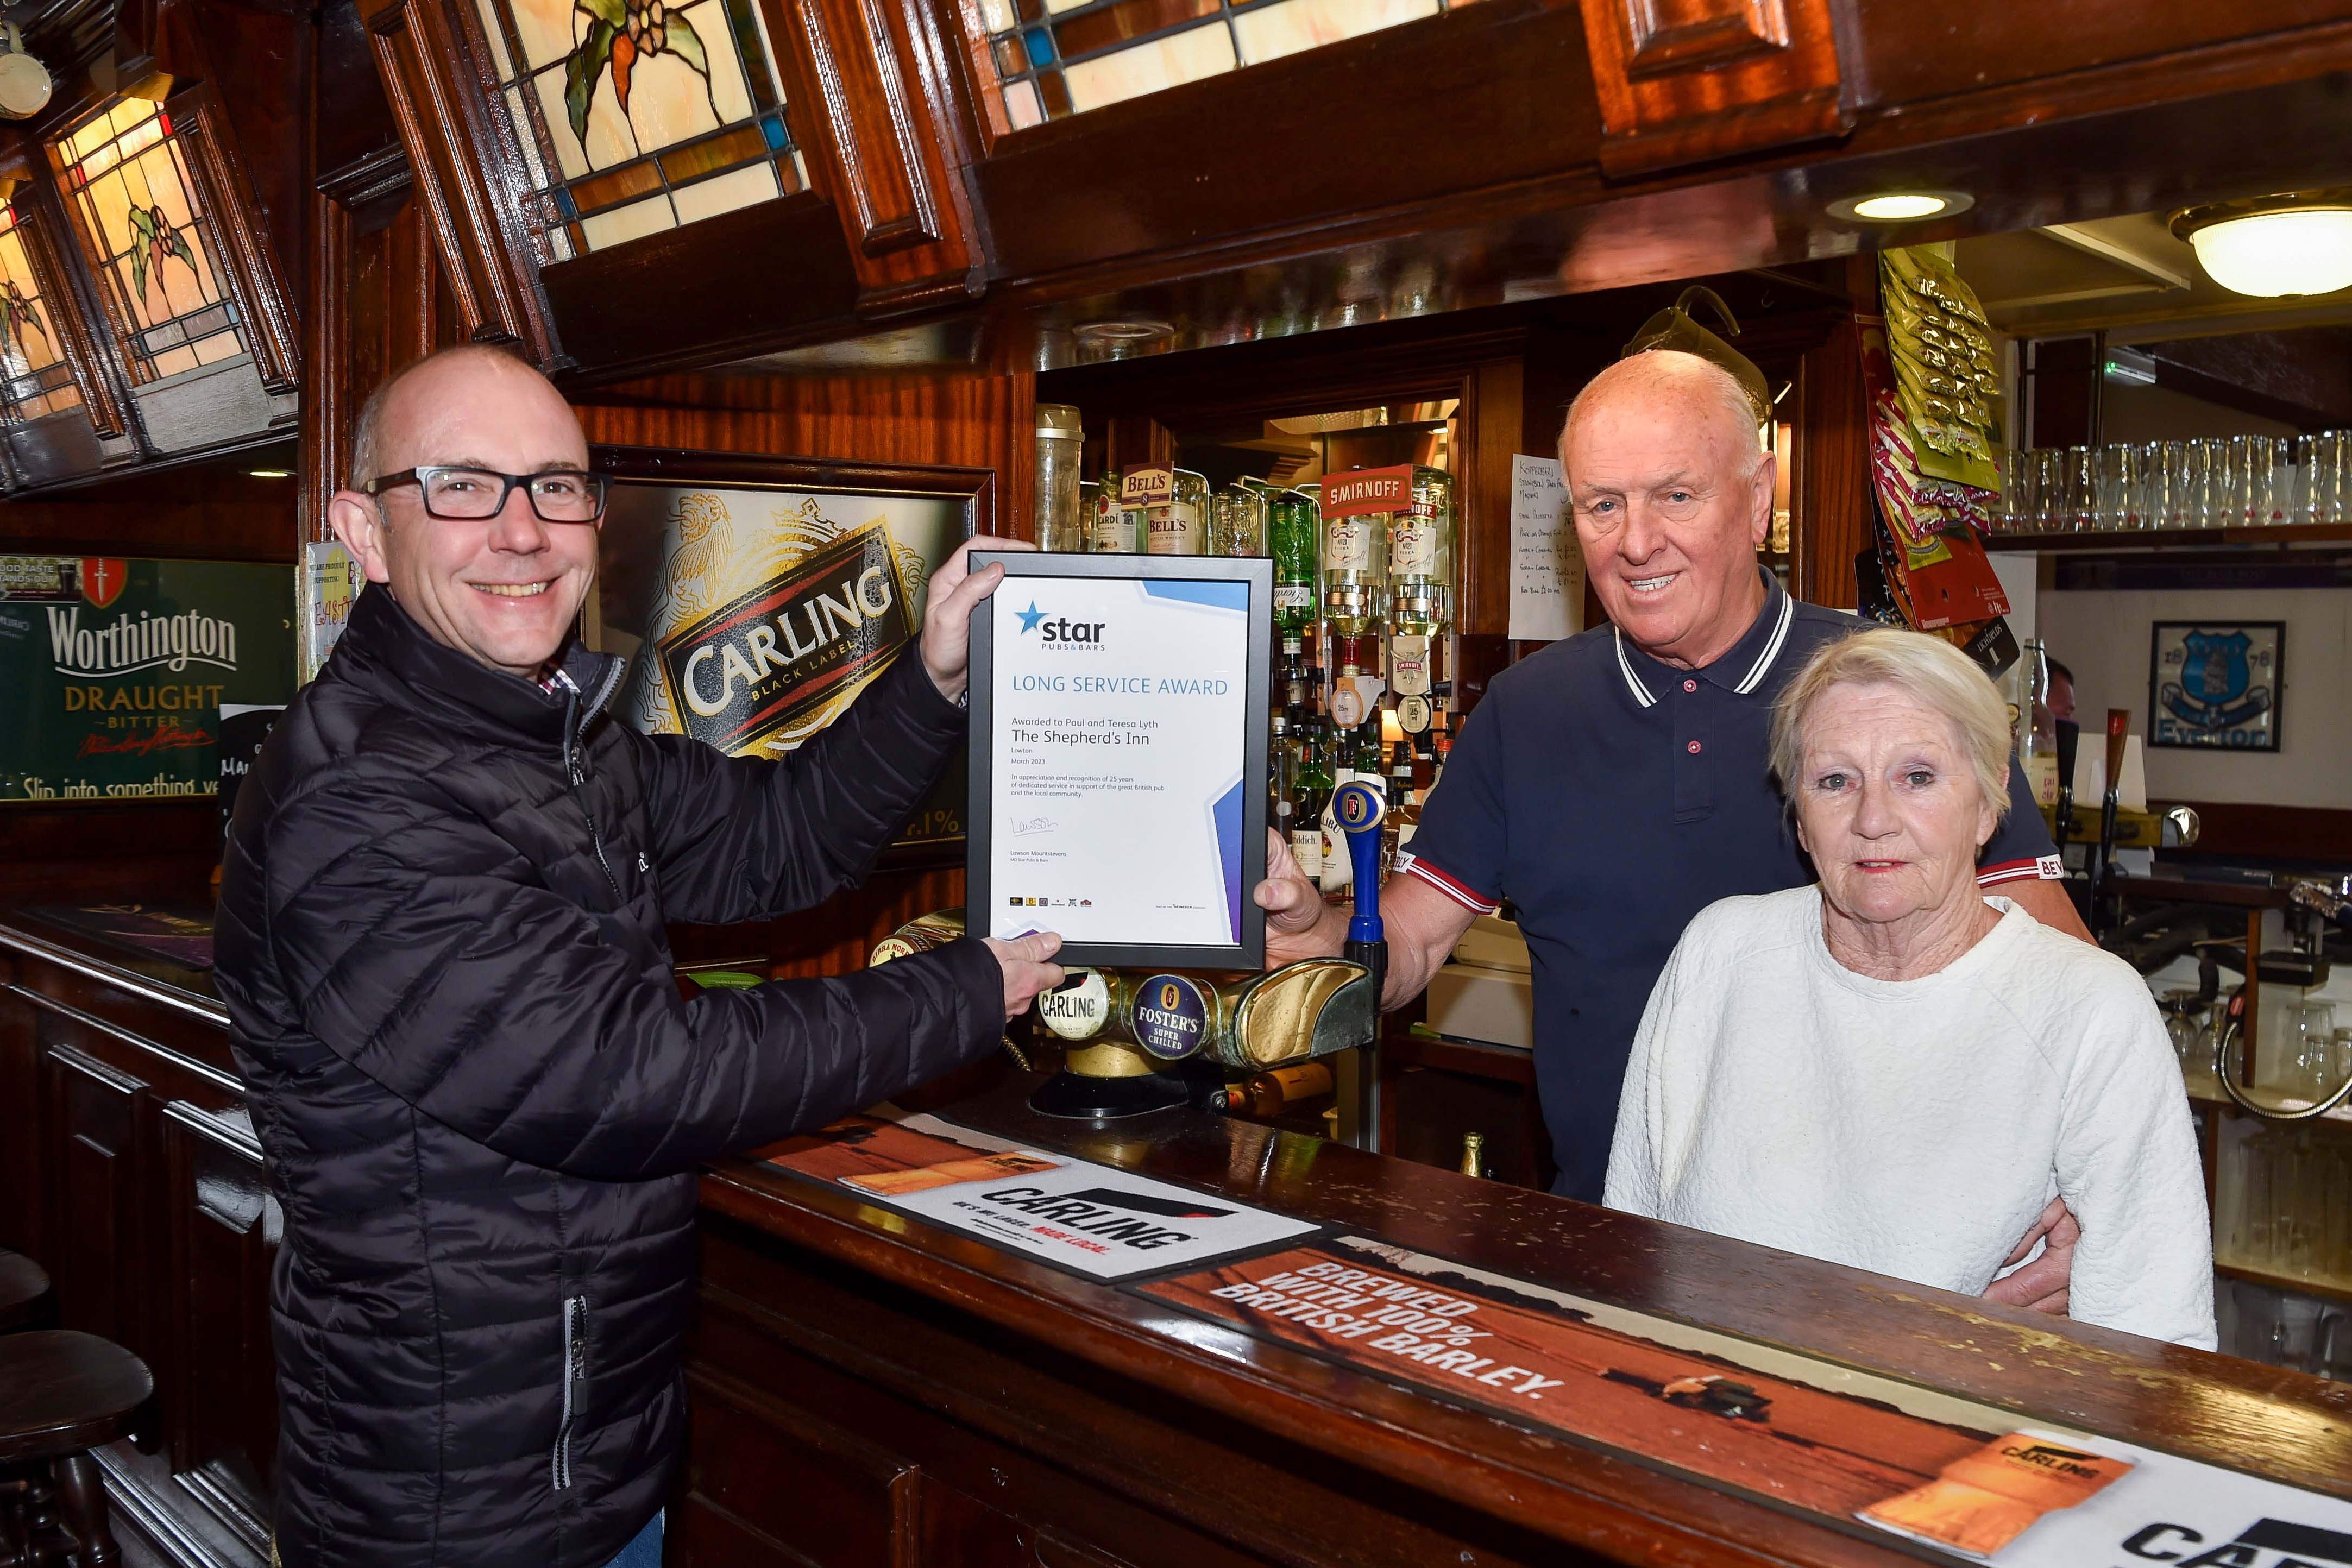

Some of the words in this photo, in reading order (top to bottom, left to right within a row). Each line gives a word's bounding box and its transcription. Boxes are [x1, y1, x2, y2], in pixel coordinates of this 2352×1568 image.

[1127, 474, 1166, 492] BELL'S
[1330, 480, 1400, 505] SMIRNOFF
[1149, 517, 1187, 533] BELL'S
[46, 606, 237, 672] Worthington
[682, 565, 894, 717] CARLING
[1042, 617, 1106, 643] star
[751, 667, 803, 702] BLACK
[809, 640, 856, 672] LABEL
[1013, 675, 1066, 692] LONG
[1073, 676, 1152, 694] SERVICE
[1157, 678, 1228, 696] AWARD
[64, 685, 225, 713] DRAUGHT
[109, 716, 181, 728] BITTER
[1011, 717, 1051, 727] Awarded
[1054, 718, 1063, 727] to
[1065, 718, 1085, 727] Paul
[1087, 719, 1105, 728] and
[1107, 720, 1136, 729] Teresa
[1139, 720, 1159, 731] Lyth
[1011, 729, 1039, 744] The
[1043, 729, 1121, 746] Shepherd's
[1126, 732, 1150, 745] Inn
[64, 778, 98, 798] into
[106, 772, 195, 797] something
[1042, 994, 1095, 1018] CARLING
[1139, 1006, 1198, 1034] FOSTER'S
[1148, 1034, 1183, 1050] CHILLED
[1153, 1027, 1179, 1040] SUPER
[980, 1187, 1192, 1250] CARLING
[1296, 1262, 1479, 1318] BREWED
[1256, 1271, 1367, 1311] WITH
[1361, 1302, 1493, 1347] 100%
[1210, 1282, 1386, 1339] BRITISH
[1366, 1330, 1566, 1400] BARLEY.
[2001, 1446, 2101, 1479] CARLING
